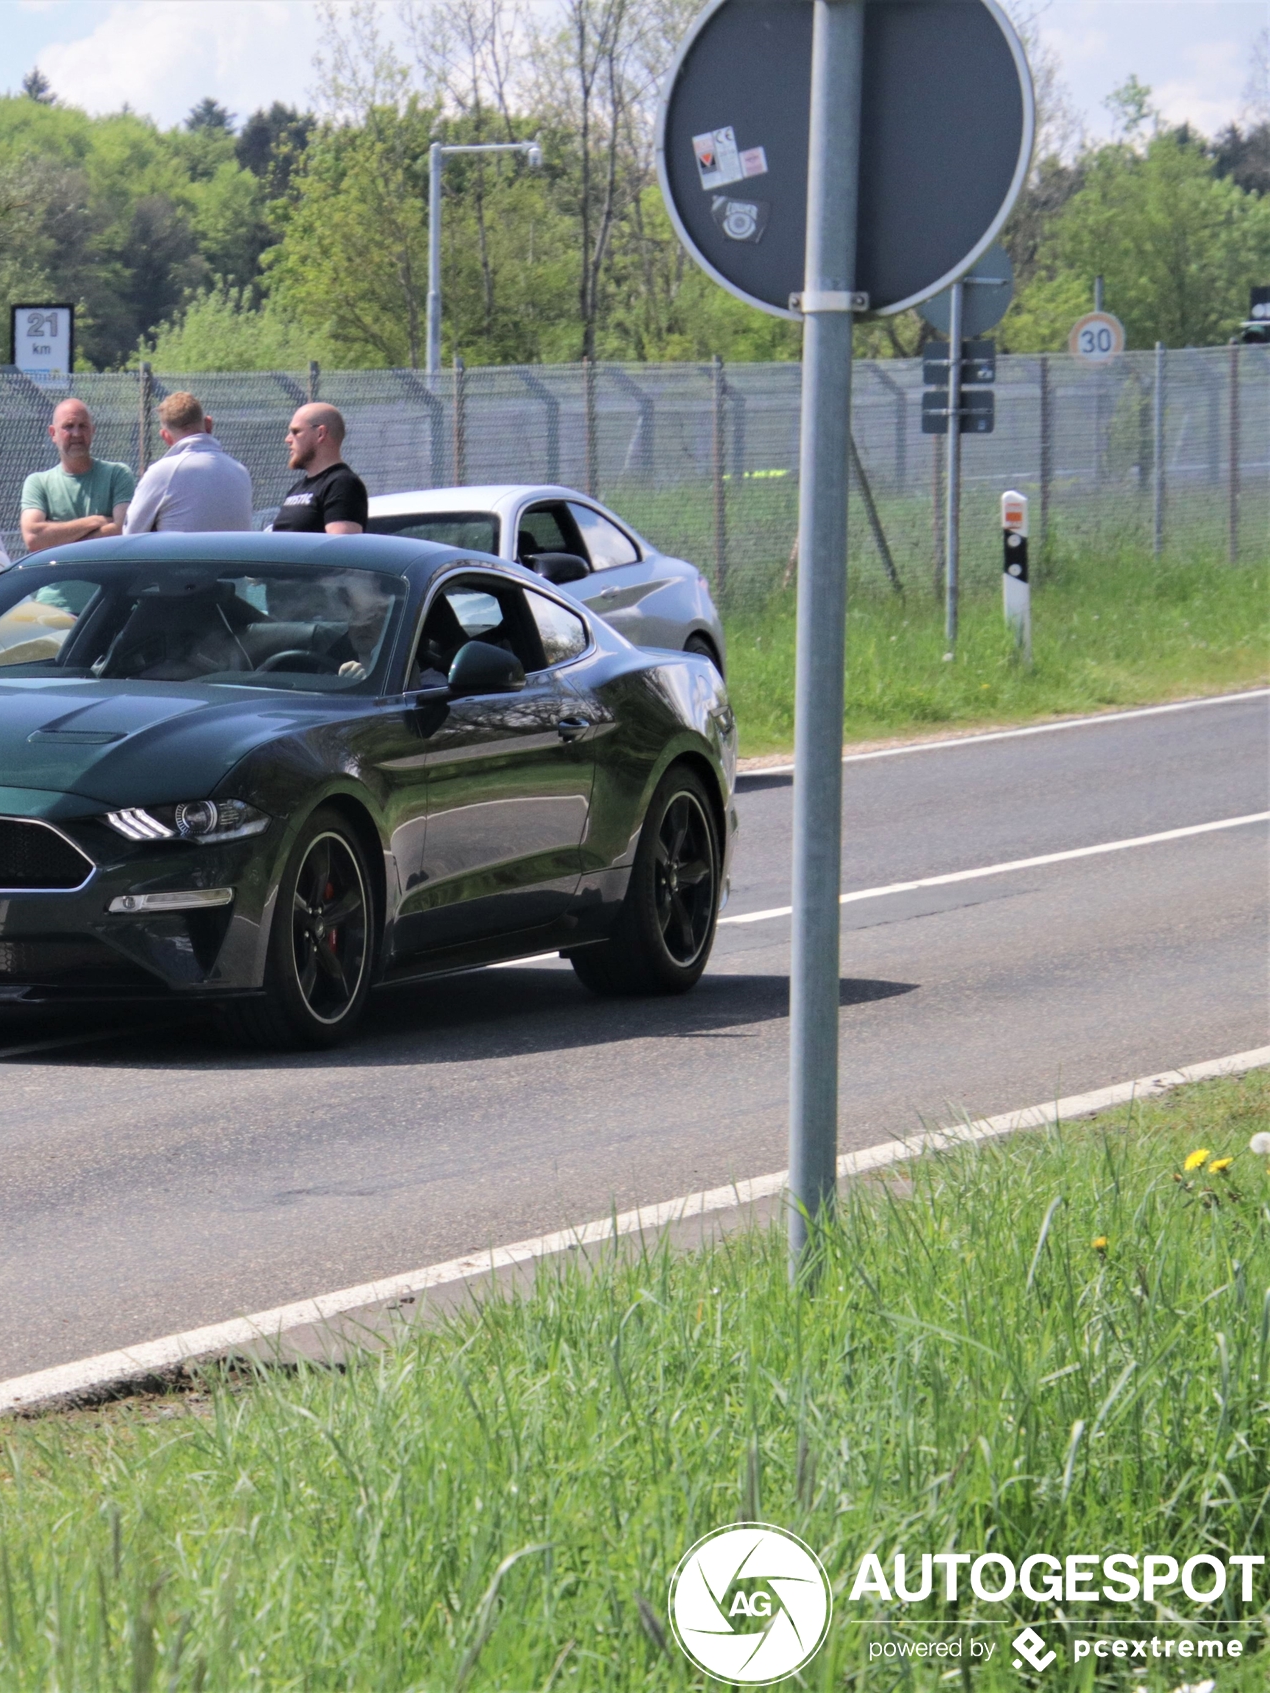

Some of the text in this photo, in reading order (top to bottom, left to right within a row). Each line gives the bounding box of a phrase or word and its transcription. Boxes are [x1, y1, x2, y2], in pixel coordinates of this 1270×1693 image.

[27, 312, 58, 337] 21
[33, 343, 51, 355] km
[1081, 328, 1112, 353] 30
